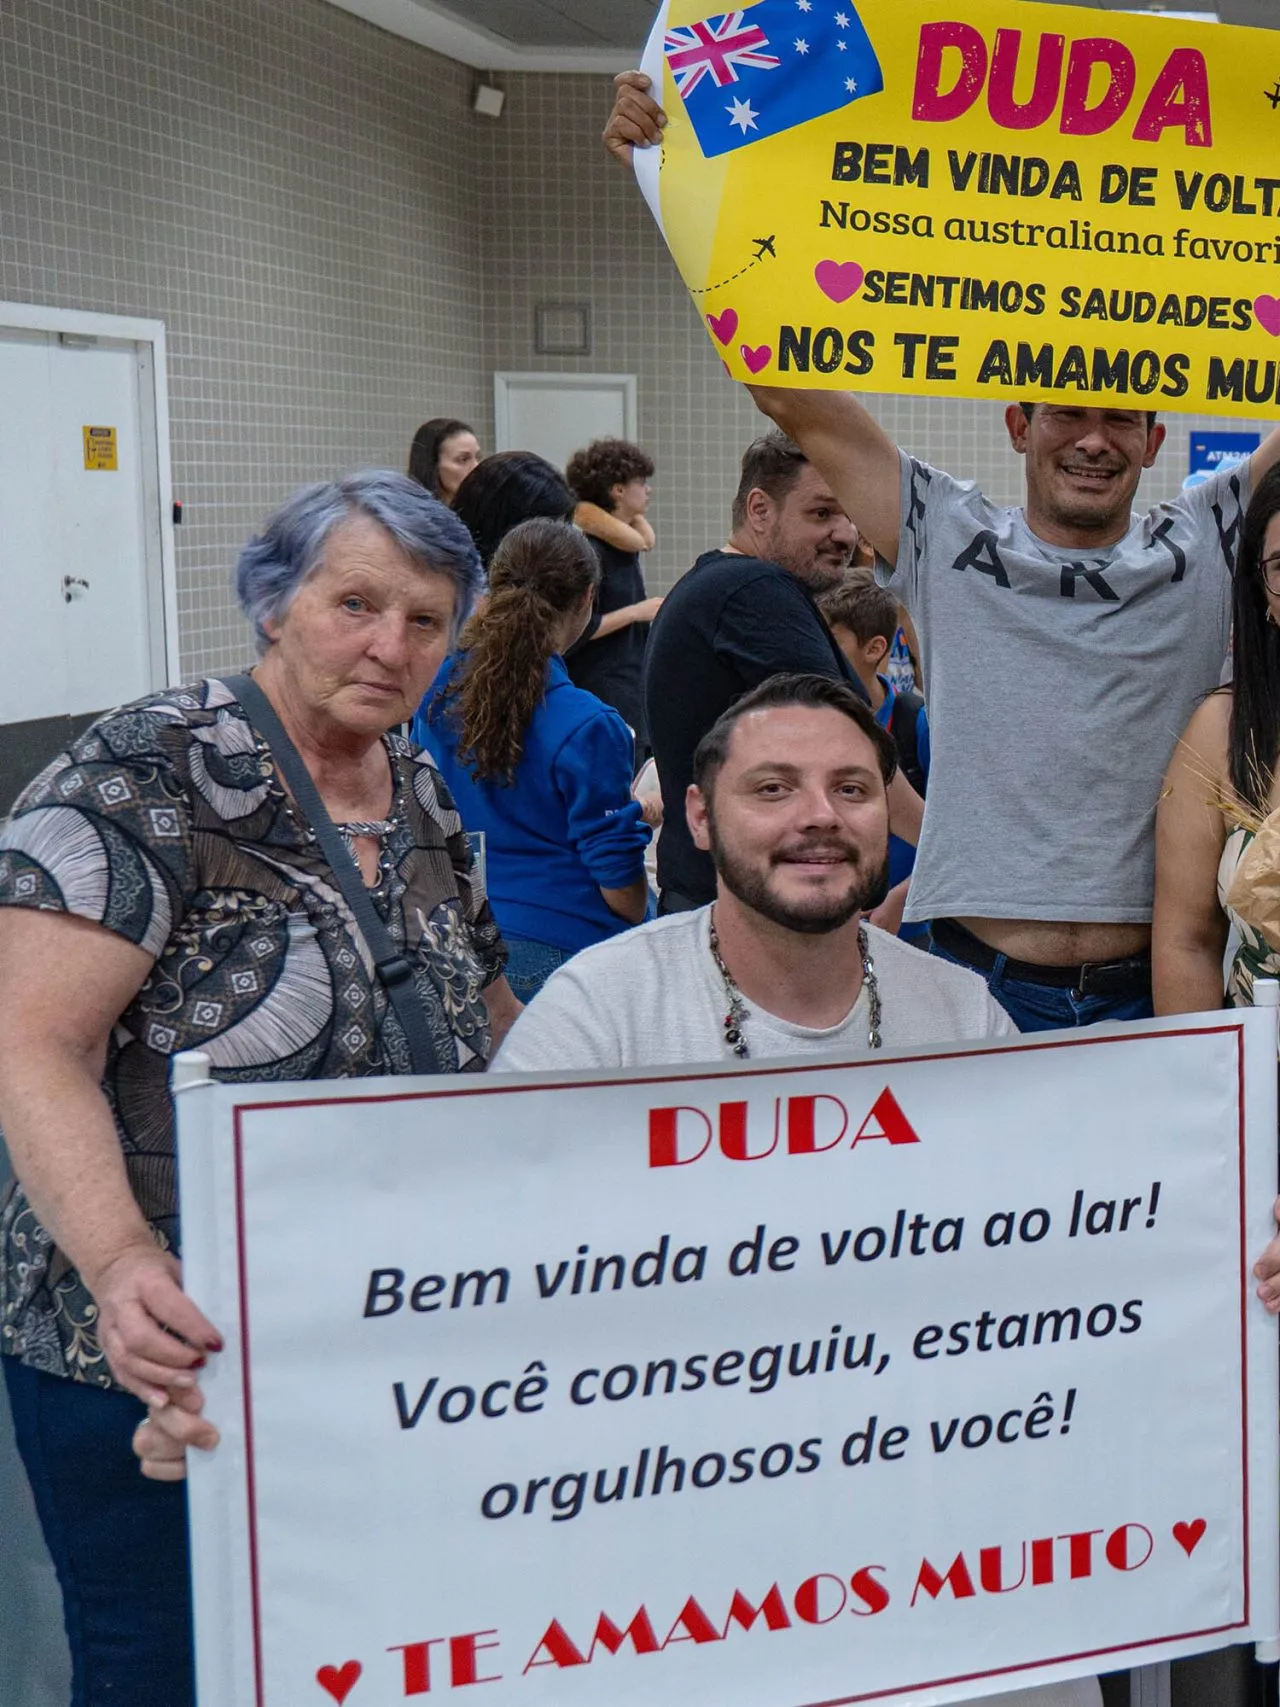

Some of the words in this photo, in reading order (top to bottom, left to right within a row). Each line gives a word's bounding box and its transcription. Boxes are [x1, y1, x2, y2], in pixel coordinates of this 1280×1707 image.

[911, 21, 1213, 148] DUDA
[831, 141, 930, 189] BEM
[947, 149, 1083, 202] VINDA
[1099, 164, 1158, 207] DE
[819, 200, 935, 238] Nossa
[944, 218, 1165, 256] australiana
[862, 270, 1046, 315] SENTIMOS
[1059, 286, 1253, 331] SAUDADES
[778, 325, 875, 376] NOS
[893, 332, 960, 381] TE
[976, 339, 1190, 398] AMAMOS
[648, 1087, 919, 1168] DUDA
[363, 1268, 509, 1318] Bem
[535, 1235, 707, 1298] vinda
[728, 1225, 799, 1277] de
[821, 1209, 964, 1266] volta
[983, 1208, 1050, 1248] ao
[1068, 1181, 1161, 1238] lar!
[393, 1361, 547, 1429] Você
[570, 1325, 890, 1405] conseguiu,
[913, 1299, 1143, 1360] estamos
[481, 1438, 822, 1522] orgulhosos
[841, 1416, 909, 1466] de
[930, 1388, 1077, 1453] você!
[386, 1628, 501, 1697] TE
[522, 1566, 890, 1676] AMAMOS
[910, 1523, 1154, 1607] MUITO
